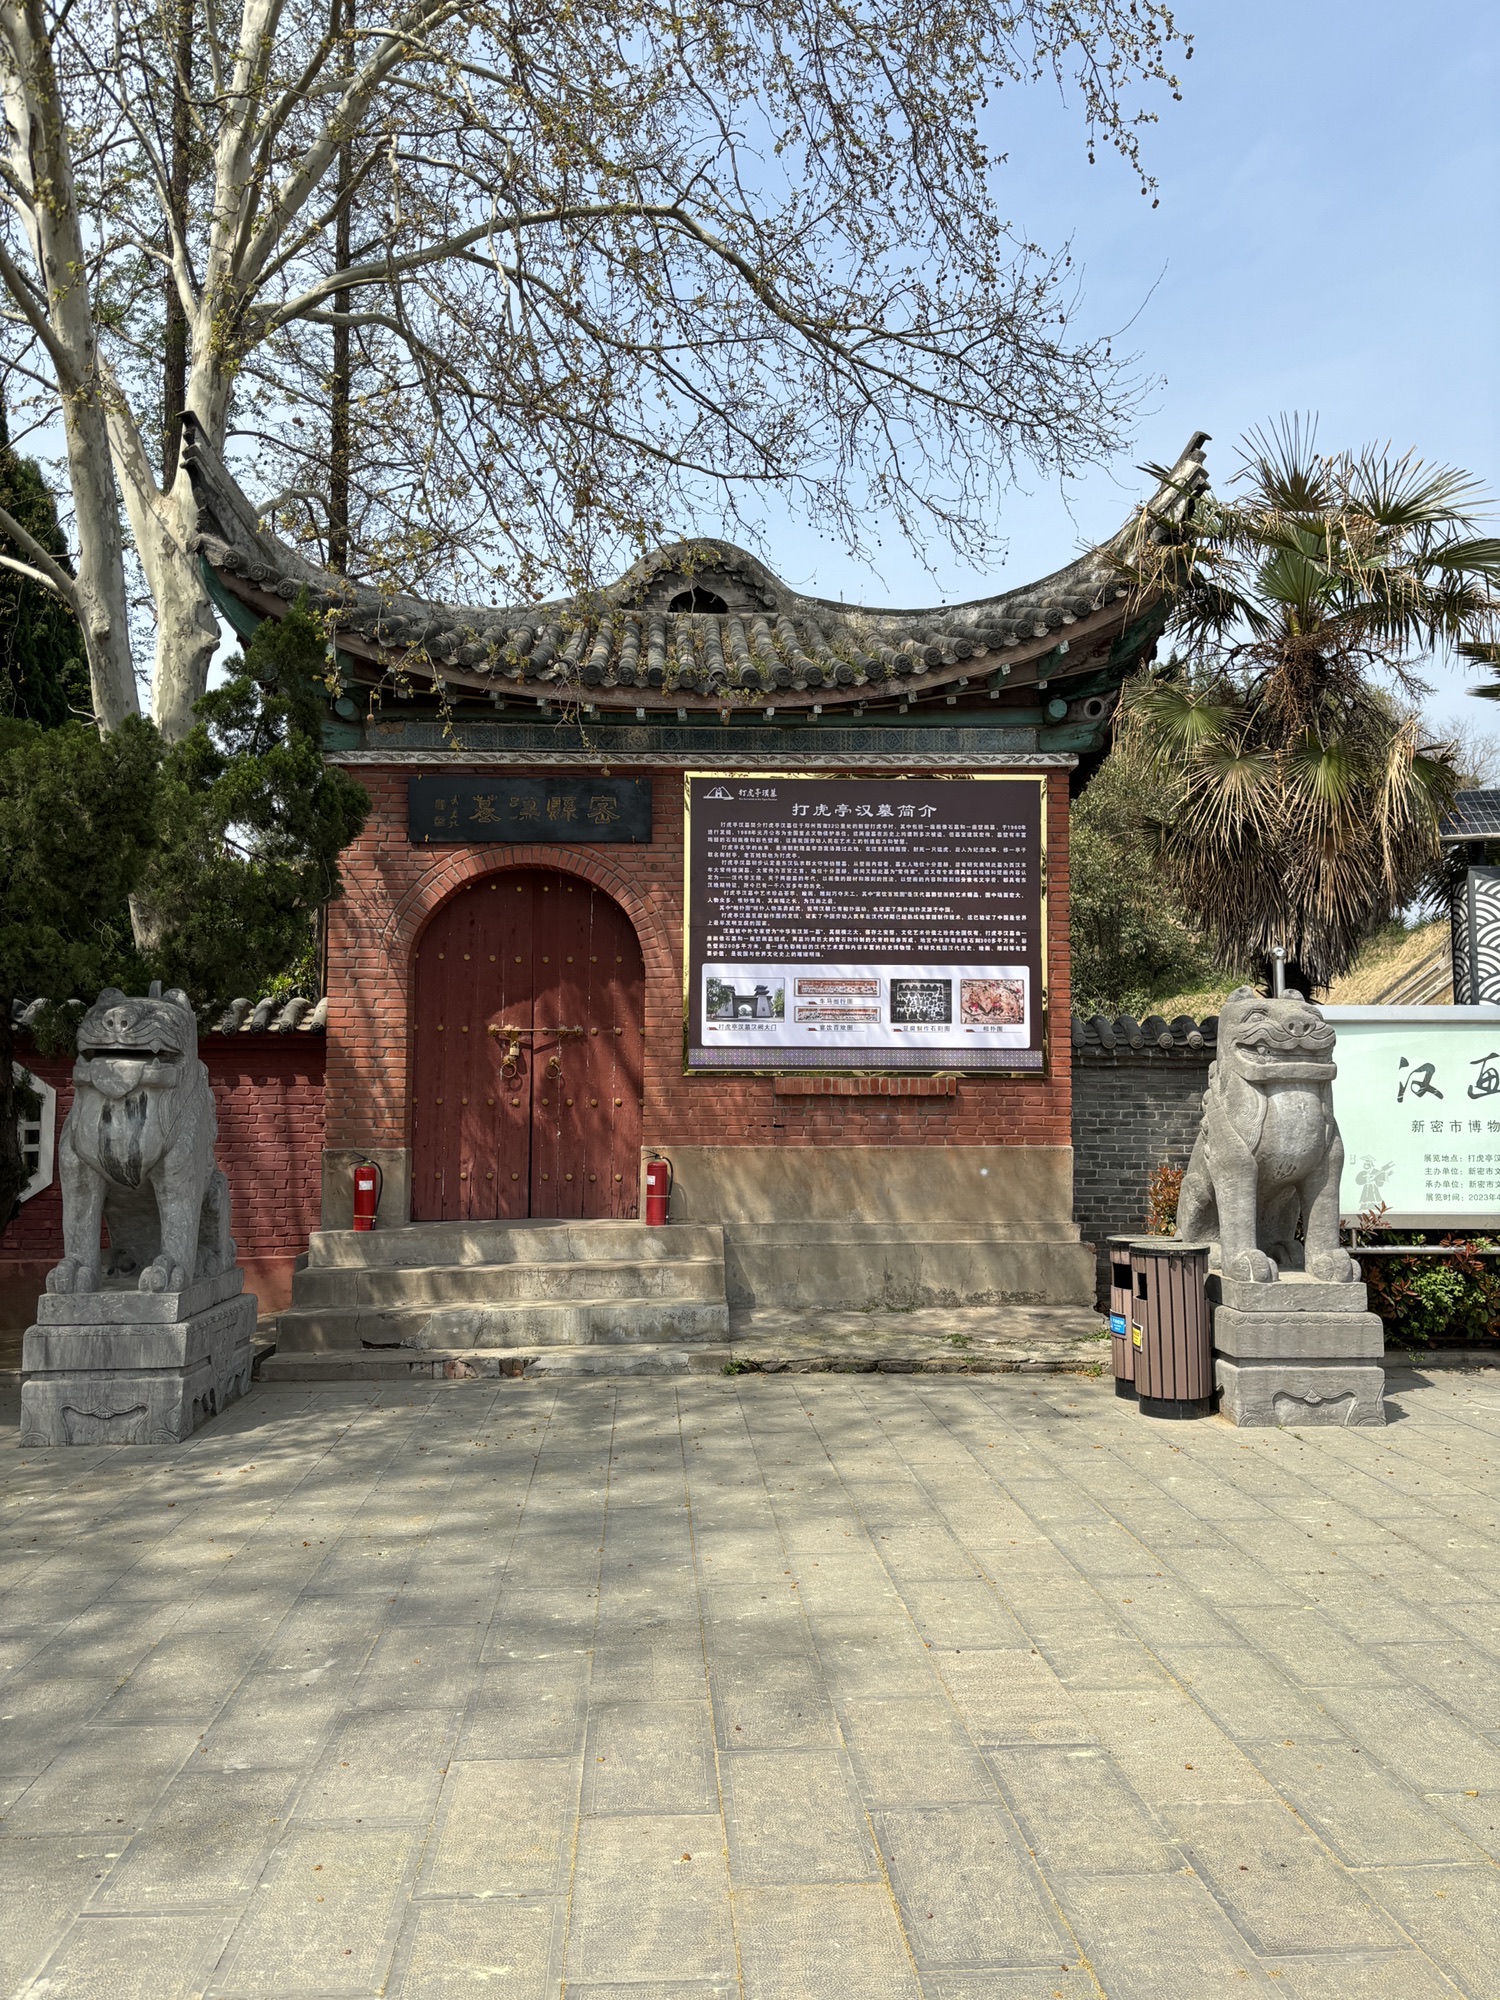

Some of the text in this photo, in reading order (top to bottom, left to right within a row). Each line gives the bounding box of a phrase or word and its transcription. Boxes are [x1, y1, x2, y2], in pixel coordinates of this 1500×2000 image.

[792, 803, 937, 818] 打虎亭汉墓简介
